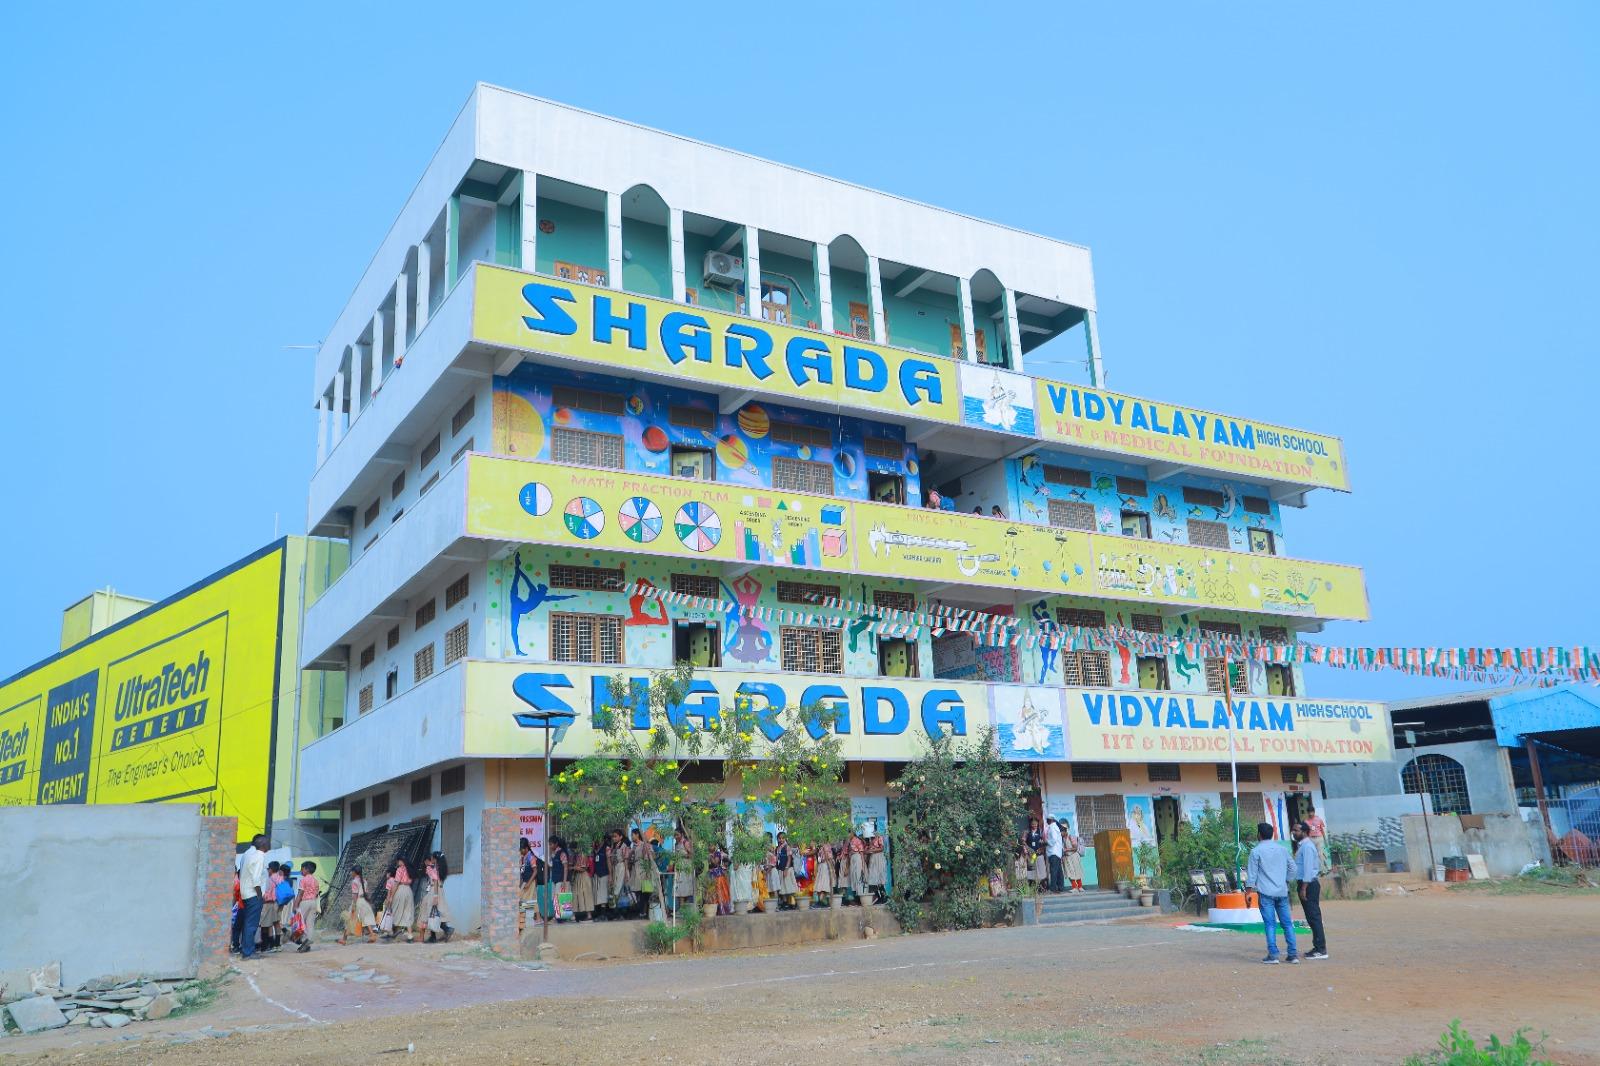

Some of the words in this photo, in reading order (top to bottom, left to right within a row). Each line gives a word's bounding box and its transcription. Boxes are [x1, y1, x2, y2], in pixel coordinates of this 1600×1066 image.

[520, 283, 943, 407] SHARADA
[1046, 383, 1256, 450] VIDYALAYAM
[1256, 429, 1281, 447] HIGH
[1282, 434, 1329, 457] SCHOOL
[1055, 420, 1083, 437] IIT
[1104, 429, 1192, 458] MEDICAL
[1200, 447, 1313, 478] FOUNDATION
[570, 476, 615, 489] MATH
[622, 481, 692, 497] FRACTION
[114, 650, 211, 722] UltraTech
[51, 692, 91, 729] INDIA'S
[115, 704, 203, 747] CEMENT
[512, 672, 967, 743] SHARADA
[1081, 693, 1295, 732] VIDYALAYAM
[0, 721, 29, 762] Tech
[1102, 733, 1135, 750] IIT
[1142, 735, 1154, 750] &
[1160, 735, 1255, 753] MEDICAL
[1260, 737, 1374, 754] FOUNDATION
[107, 769, 122, 788] The
[123, 753, 168, 787] Engineer's
[170, 748, 205, 773] Choice
[41, 773, 85, 805] CEMENT
